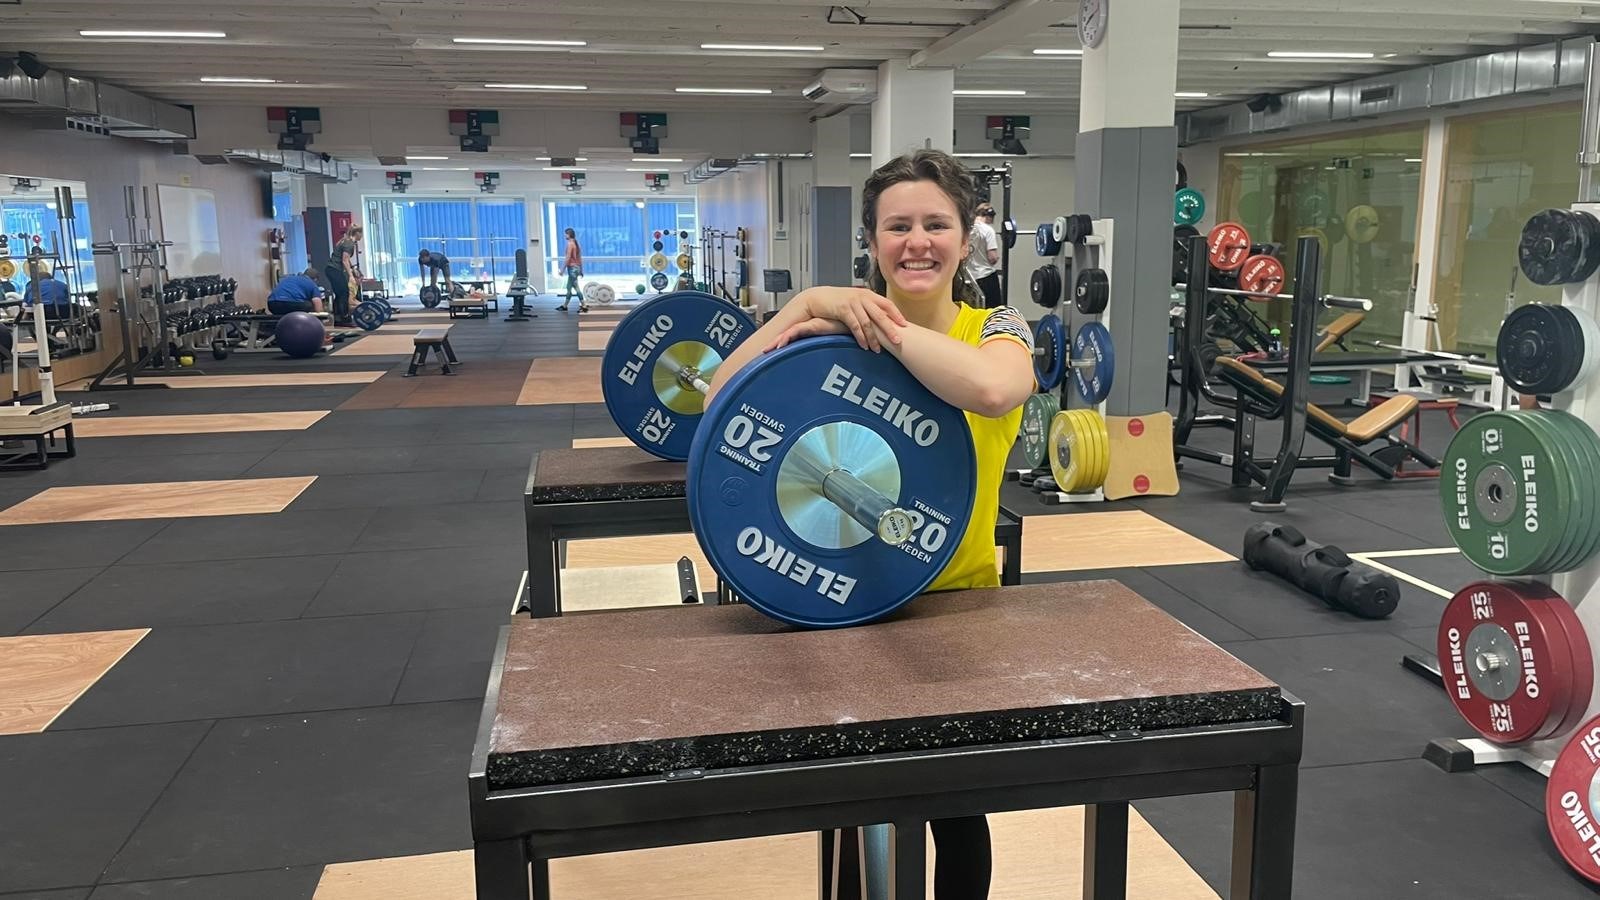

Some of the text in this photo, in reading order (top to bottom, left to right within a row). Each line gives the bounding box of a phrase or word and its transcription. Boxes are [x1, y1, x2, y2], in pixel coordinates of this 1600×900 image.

[710, 313, 738, 347] 20
[725, 323, 744, 349] SWEDEN
[618, 314, 674, 386] ELEIKO
[636, 406, 656, 433] SWEDEN
[740, 403, 786, 433] SWEDEN
[820, 364, 940, 448] ELEIKO
[642, 409, 671, 443] 20
[723, 415, 783, 462] 20
[1485, 428, 1499, 455] 10
[720, 445, 761, 472] TRAINING
[1455, 458, 1471, 530] ELEIKO
[1520, 455, 1539, 532] ELEIKO
[914, 500, 952, 525] TRAINING
[897, 542, 932, 564] WEDEN
[1491, 531, 1505, 559] 10
[736, 526, 858, 605] ELEIKO
[1474, 591, 1490, 620] 25
[1448, 627, 1471, 699] ELEIKO
[1514, 621, 1540, 699] ELEIKO
[1493, 703, 1510, 732] 25
